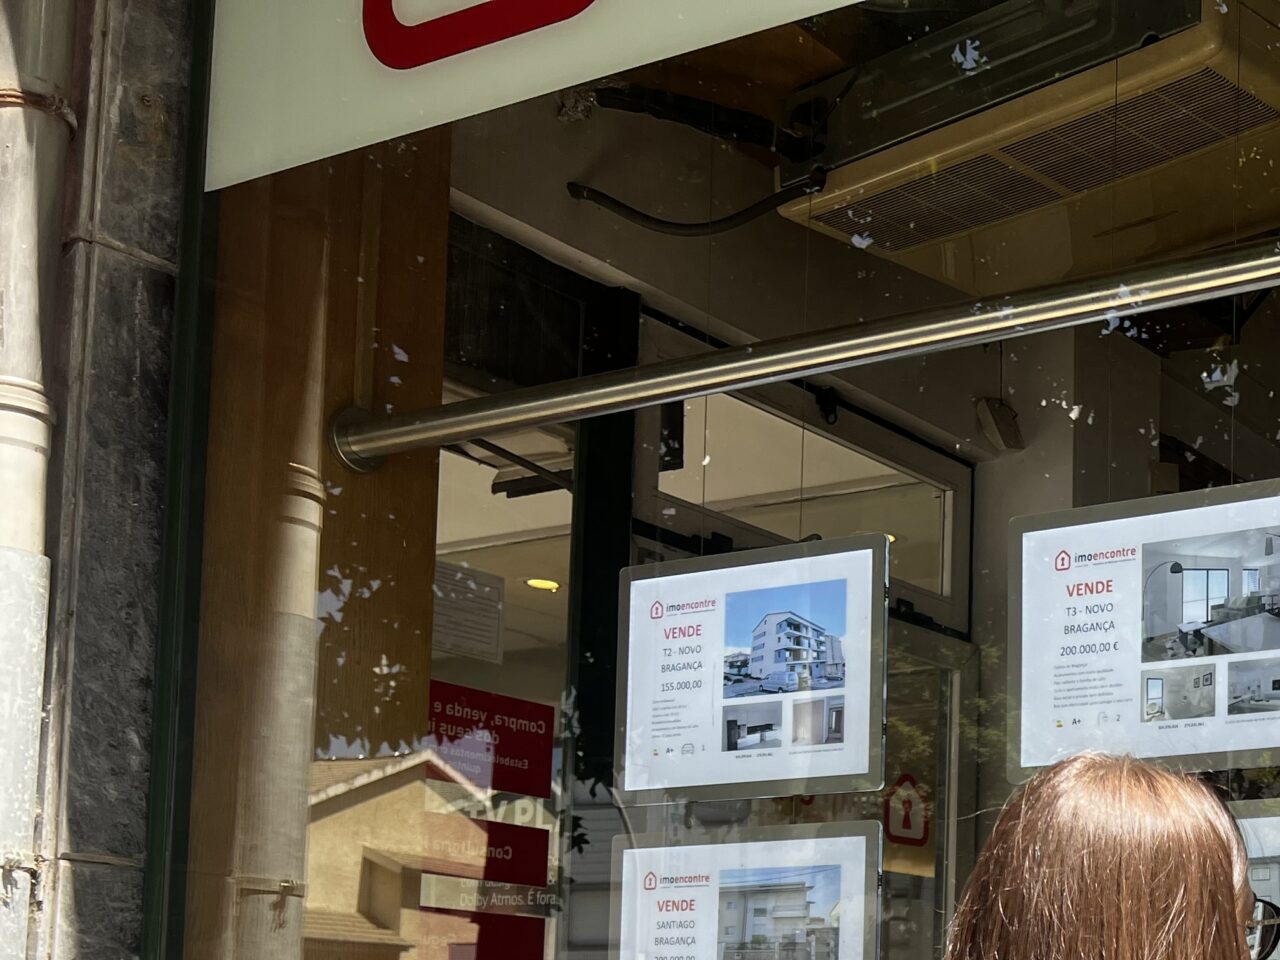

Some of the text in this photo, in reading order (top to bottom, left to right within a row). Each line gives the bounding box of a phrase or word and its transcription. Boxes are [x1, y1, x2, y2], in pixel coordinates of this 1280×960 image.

[1074, 547, 1136, 563] imoencontre
[1066, 580, 1113, 597] VENDE
[666, 600, 716, 612] imoencontre
[1066, 606, 1077, 616] T3
[1085, 603, 1114, 614] NOVO
[664, 624, 702, 640] VENDE
[1064, 621, 1115, 635] BRAGANÇA
[663, 648, 673, 657] T2
[679, 645, 702, 655] NOVO
[1060, 642, 1119, 656] 200.000,00 €
[661, 661, 703, 673] BRAGANÇA
[661, 680, 702, 692] 155.000,00
[659, 874, 710, 884] imoencontre
[657, 899, 696, 912] VENDE
[656, 920, 695, 930] SANTIAGO
[654, 936, 696, 947] BRAGANÇA
